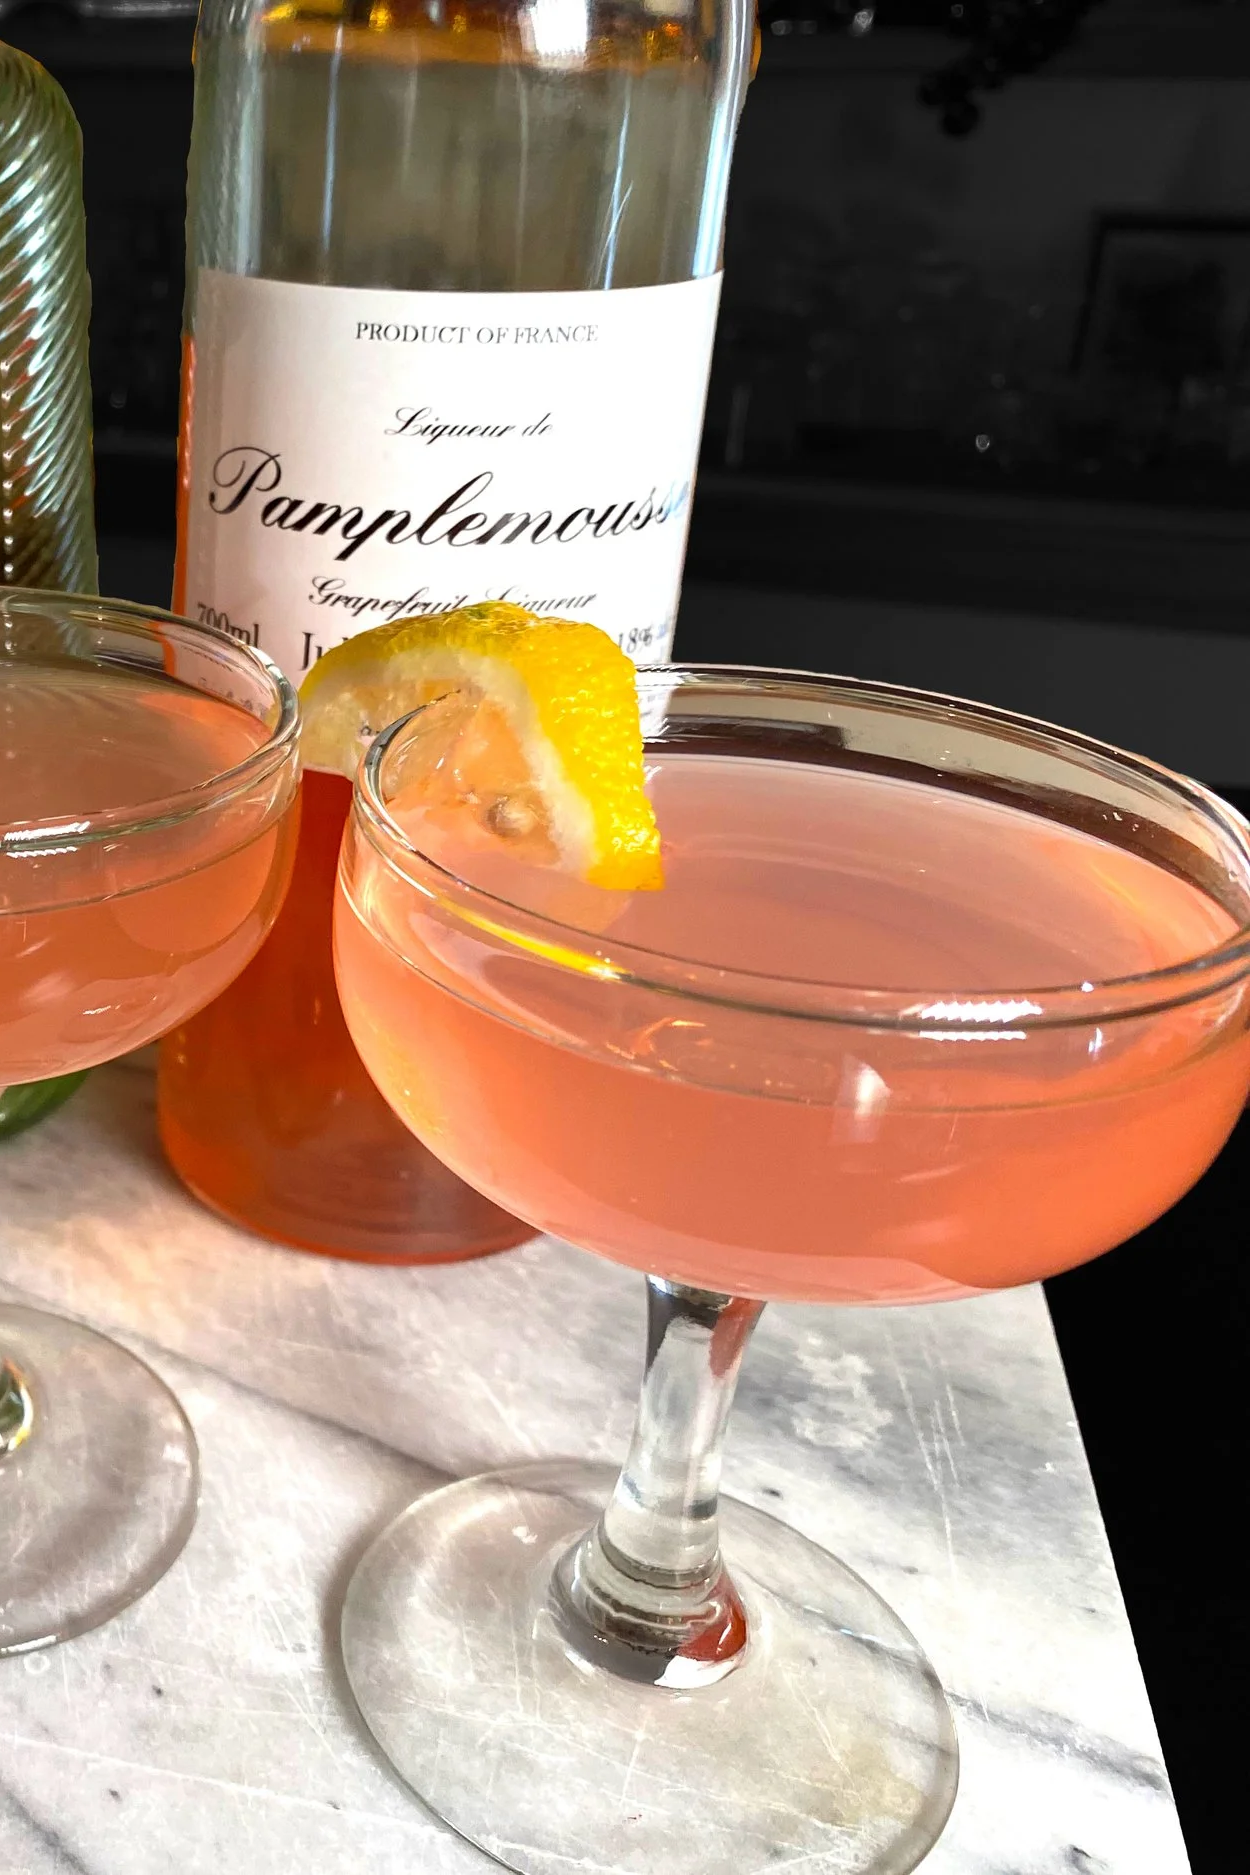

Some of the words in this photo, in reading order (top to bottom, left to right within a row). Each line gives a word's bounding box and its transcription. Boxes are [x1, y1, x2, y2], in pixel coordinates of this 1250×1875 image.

[355, 321, 470, 344] PRODUCT
[476, 327, 509, 344] OF
[513, 324, 599, 344] FRANCE
[383, 406, 516, 446] Liqueur
[521, 412, 554, 437] de
[197, 602, 260, 648] 700ml
